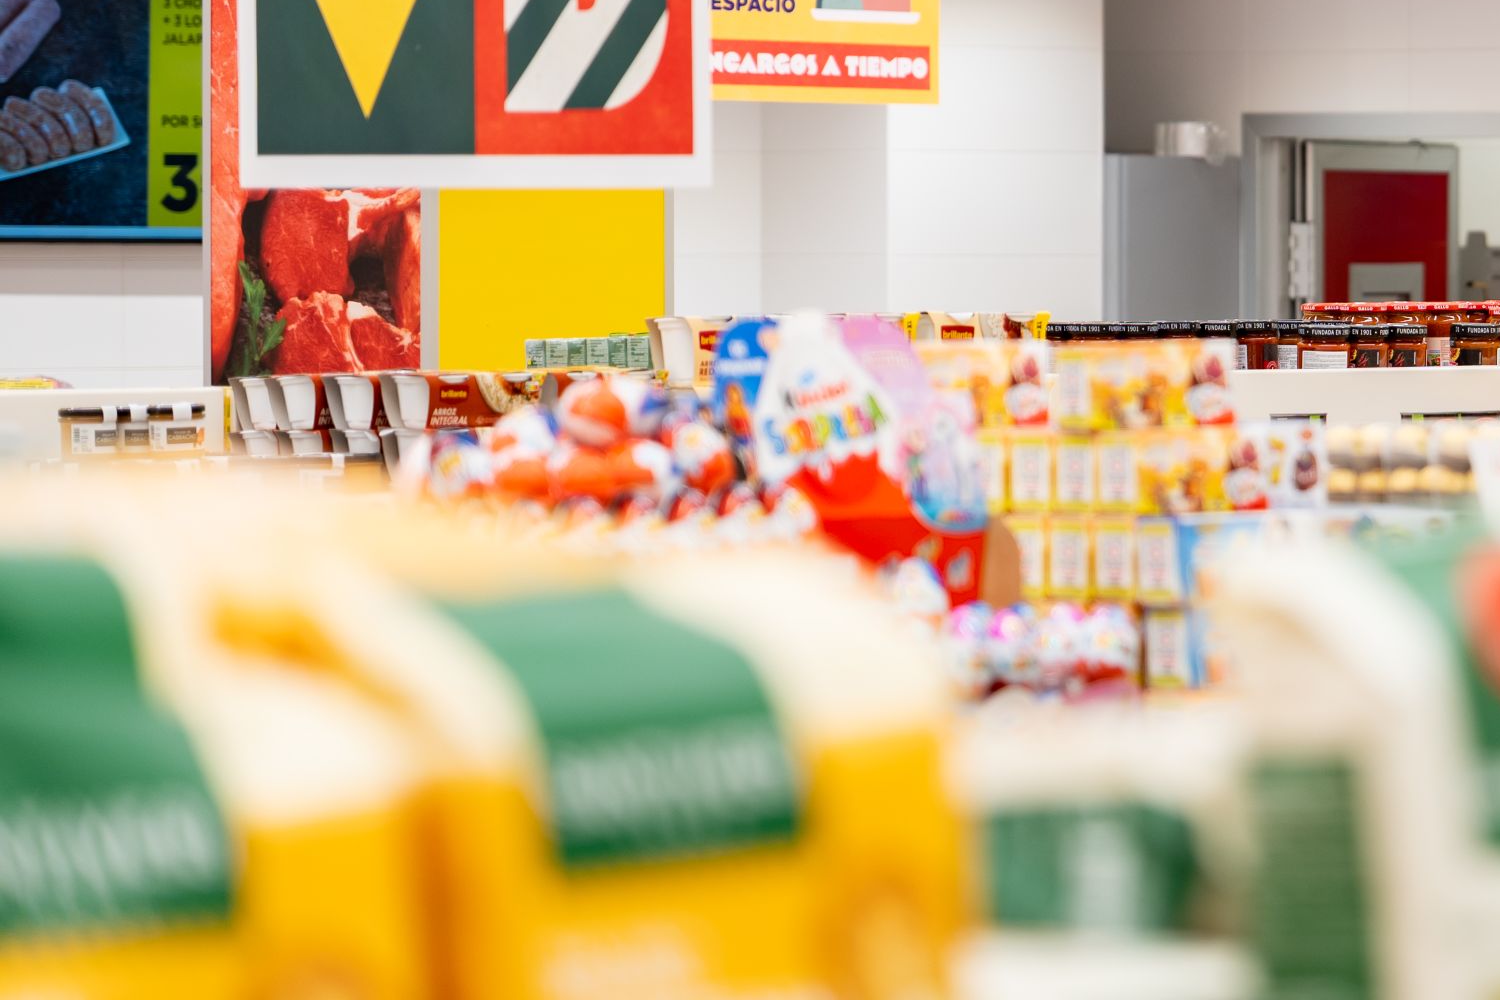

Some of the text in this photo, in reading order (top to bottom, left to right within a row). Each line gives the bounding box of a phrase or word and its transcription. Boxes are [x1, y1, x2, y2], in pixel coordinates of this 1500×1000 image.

[821, 55, 842, 77] A
[845, 55, 929, 80] TIEMPO
[161, 114, 203, 128] POR S
[161, 153, 199, 213] 3
[1311, 328, 1335, 336] FUNDADA
[1360, 328, 1372, 336] 1901
[440, 389, 468, 399] brillante
[432, 407, 458, 416] ARROZ
[430, 415, 468, 426] INTEGRAL
